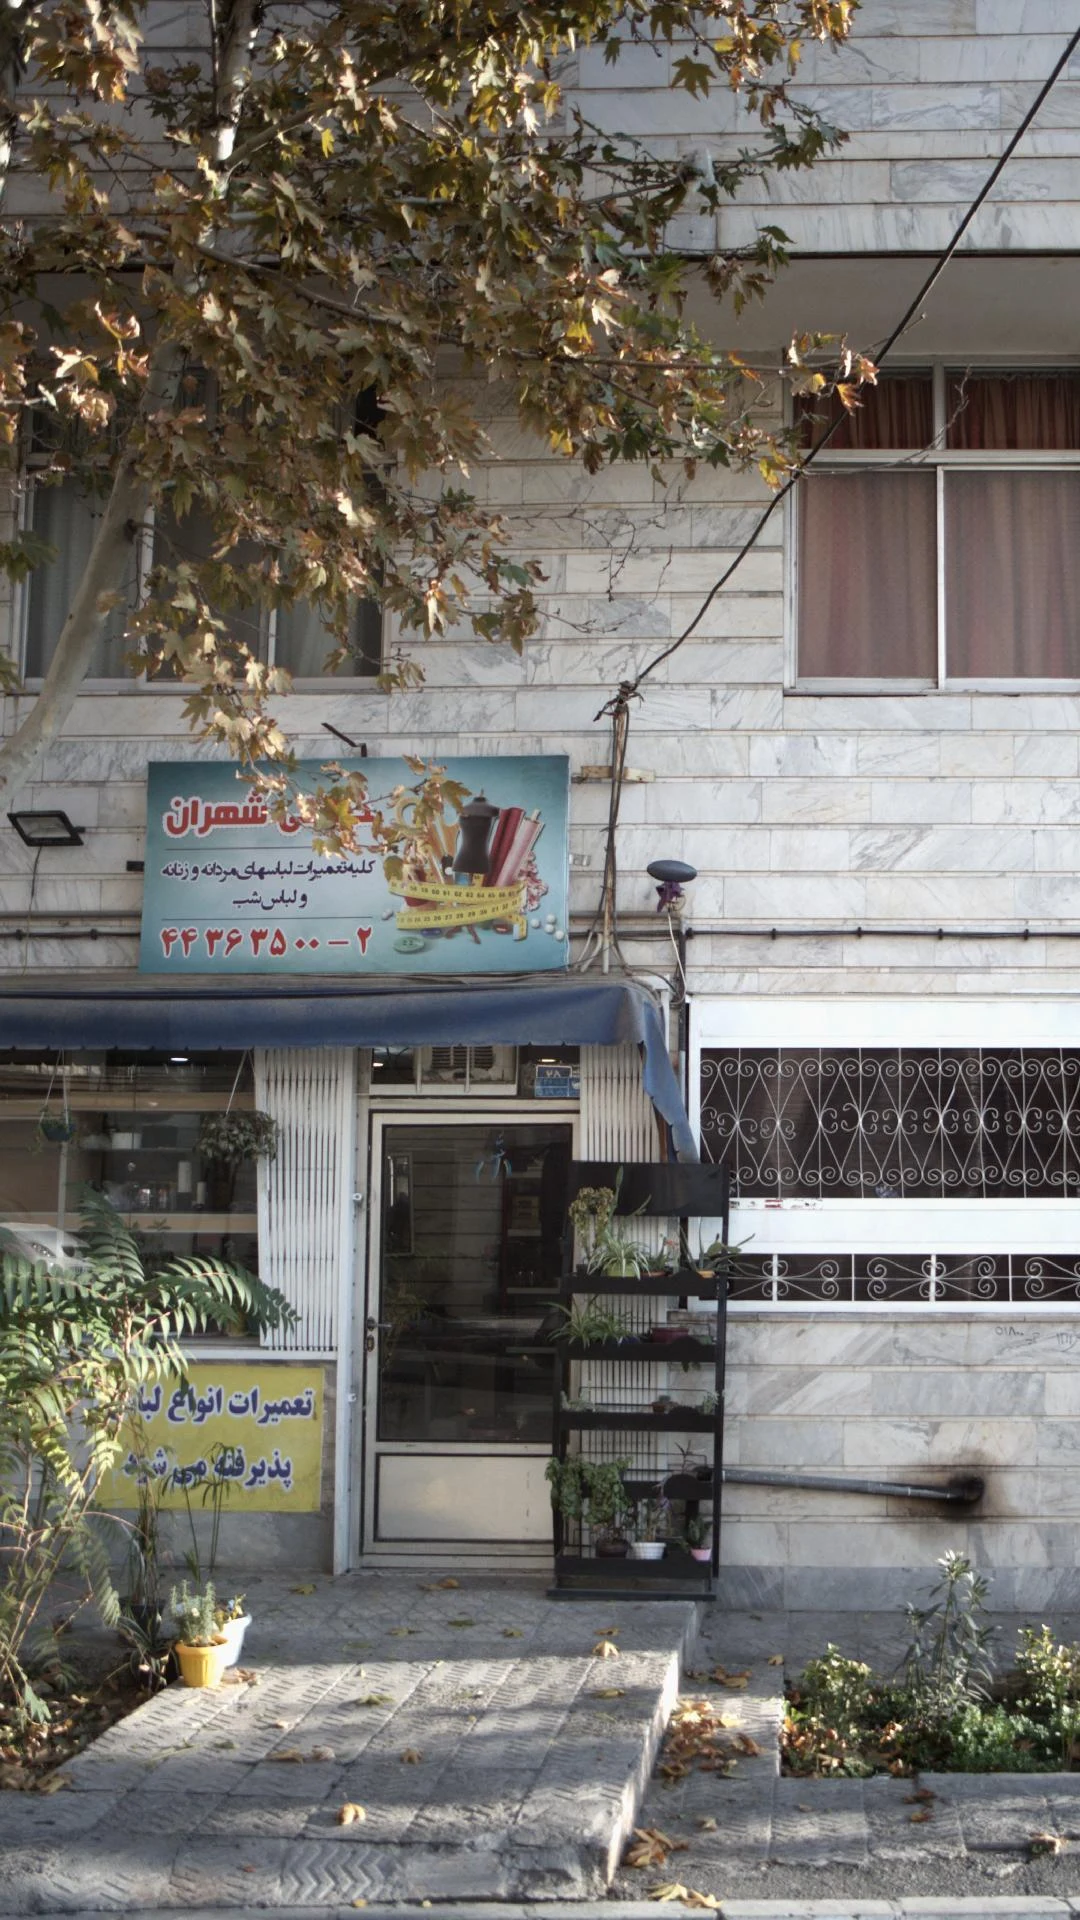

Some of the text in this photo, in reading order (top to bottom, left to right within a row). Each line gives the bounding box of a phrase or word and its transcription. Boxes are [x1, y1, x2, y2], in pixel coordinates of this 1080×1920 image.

[167, 790, 267, 834] شهران
[162, 863, 189, 880] زنانه
[191, 865, 199, 881] و
[201, 862, 239, 882] مردانه
[293, 860, 347, 881] تعمیرات
[347, 860, 375, 877] کلیه
[233, 889, 308, 910] و لباس شب
[167, 1386, 222, 1422] انواع
[229, 1389, 313, 1424] تعمیرات
[172, 1460, 207, 1485] می
[215, 1449, 292, 1488] پذیرفته
